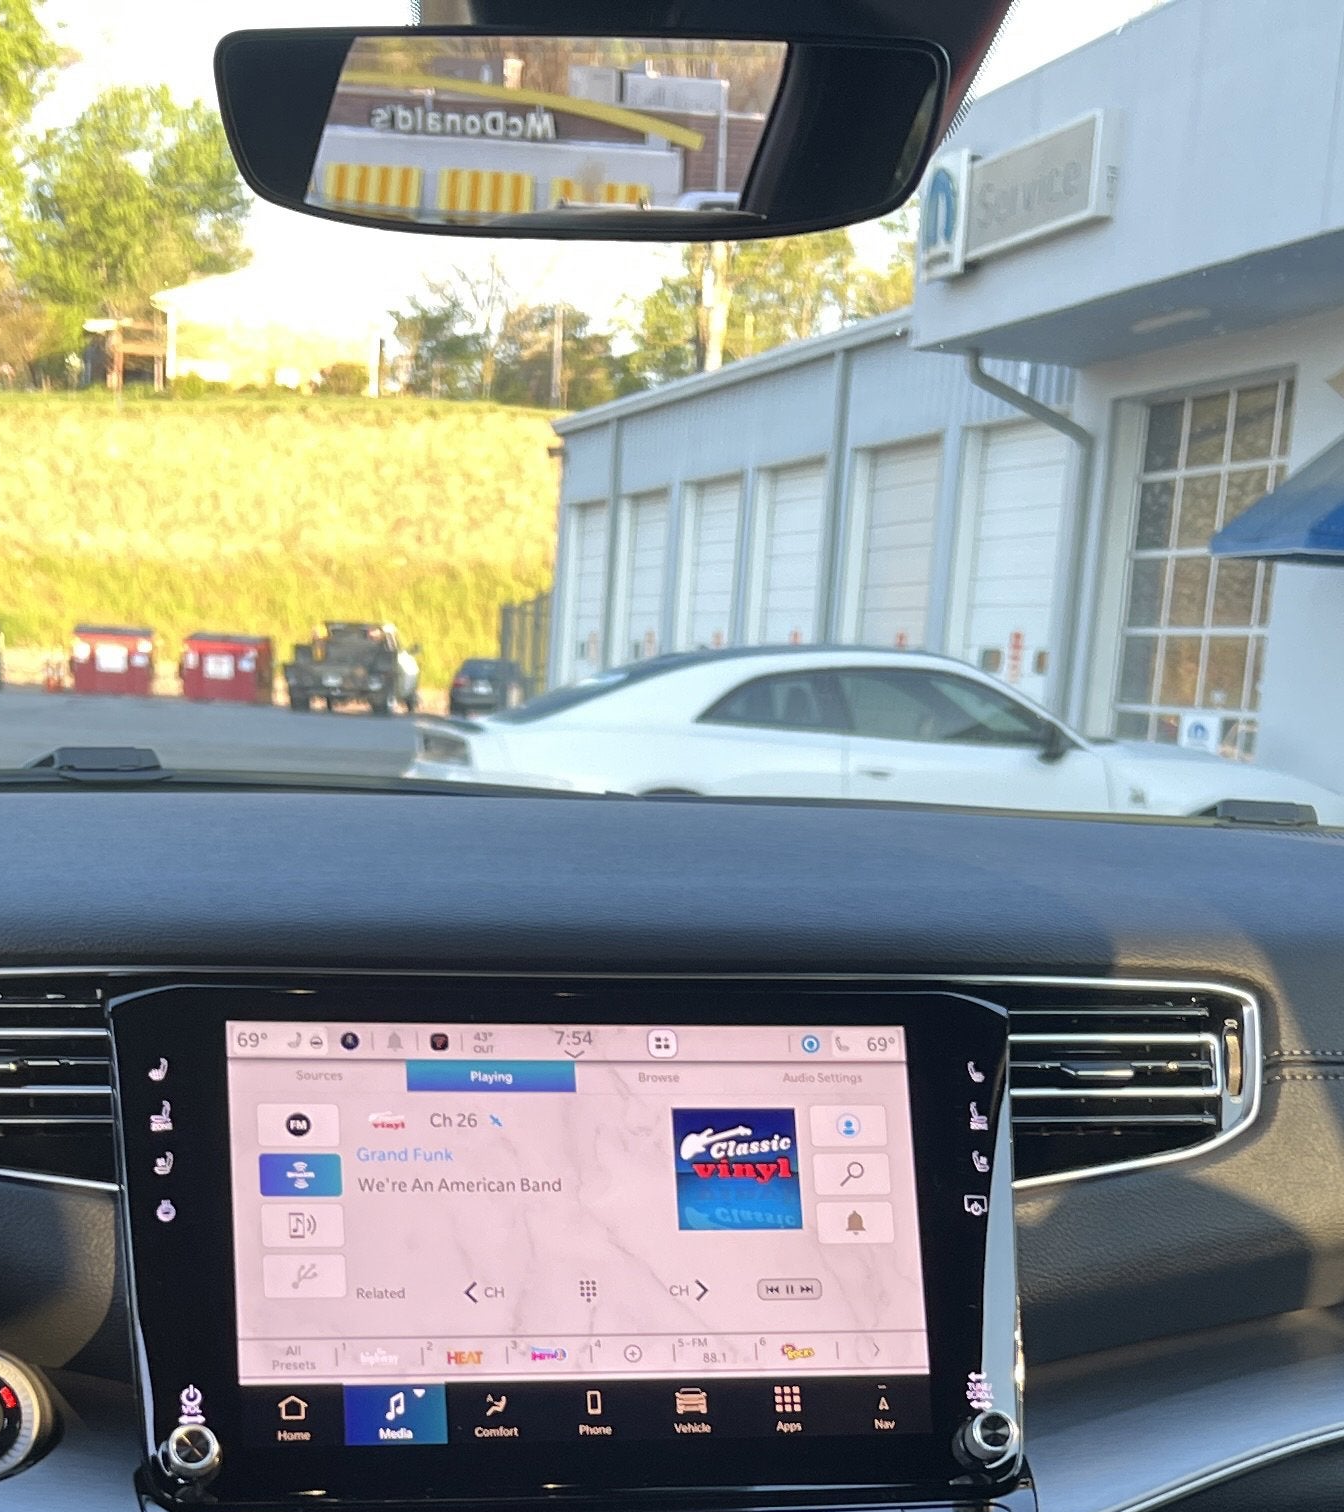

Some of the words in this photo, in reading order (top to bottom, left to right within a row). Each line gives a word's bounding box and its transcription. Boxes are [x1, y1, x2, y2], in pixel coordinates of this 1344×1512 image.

[237, 1032, 268, 1048] 69°
[555, 1031, 594, 1047] 7:54
[867, 1036, 896, 1052] 69°
[296, 1070, 344, 1082] Sources
[470, 1071, 513, 1086] Playing
[638, 1072, 680, 1083] Browse
[783, 1072, 815, 1084] Audio
[817, 1073, 863, 1086] Settings
[289, 1119, 308, 1131] FM
[430, 1113, 452, 1128] Ch
[457, 1114, 478, 1128] 26
[710, 1134, 792, 1159] Classic
[356, 1148, 407, 1162] Grand
[414, 1148, 454, 1162] Funk
[692, 1157, 792, 1184] vinyl
[358, 1178, 407, 1193] We're
[411, 1179, 435, 1193] An
[438, 1178, 515, 1193] American
[521, 1178, 563, 1193] Band
[356, 1287, 406, 1300] Related
[484, 1287, 505, 1299] CH
[669, 1285, 690, 1297] CH
[286, 1345, 302, 1356] All
[447, 1351, 484, 1365] HEAT
[703, 1353, 726, 1364] 88.1
[272, 1360, 316, 1371] Presets
[578, 1423, 613, 1436] Phone
[674, 1422, 712, 1434] Vehicle
[776, 1420, 803, 1434] Apps
[874, 1418, 896, 1430] Nav
[276, 1430, 311, 1442] Home
[379, 1427, 414, 1440] Media
[474, 1425, 520, 1439] Comfort
